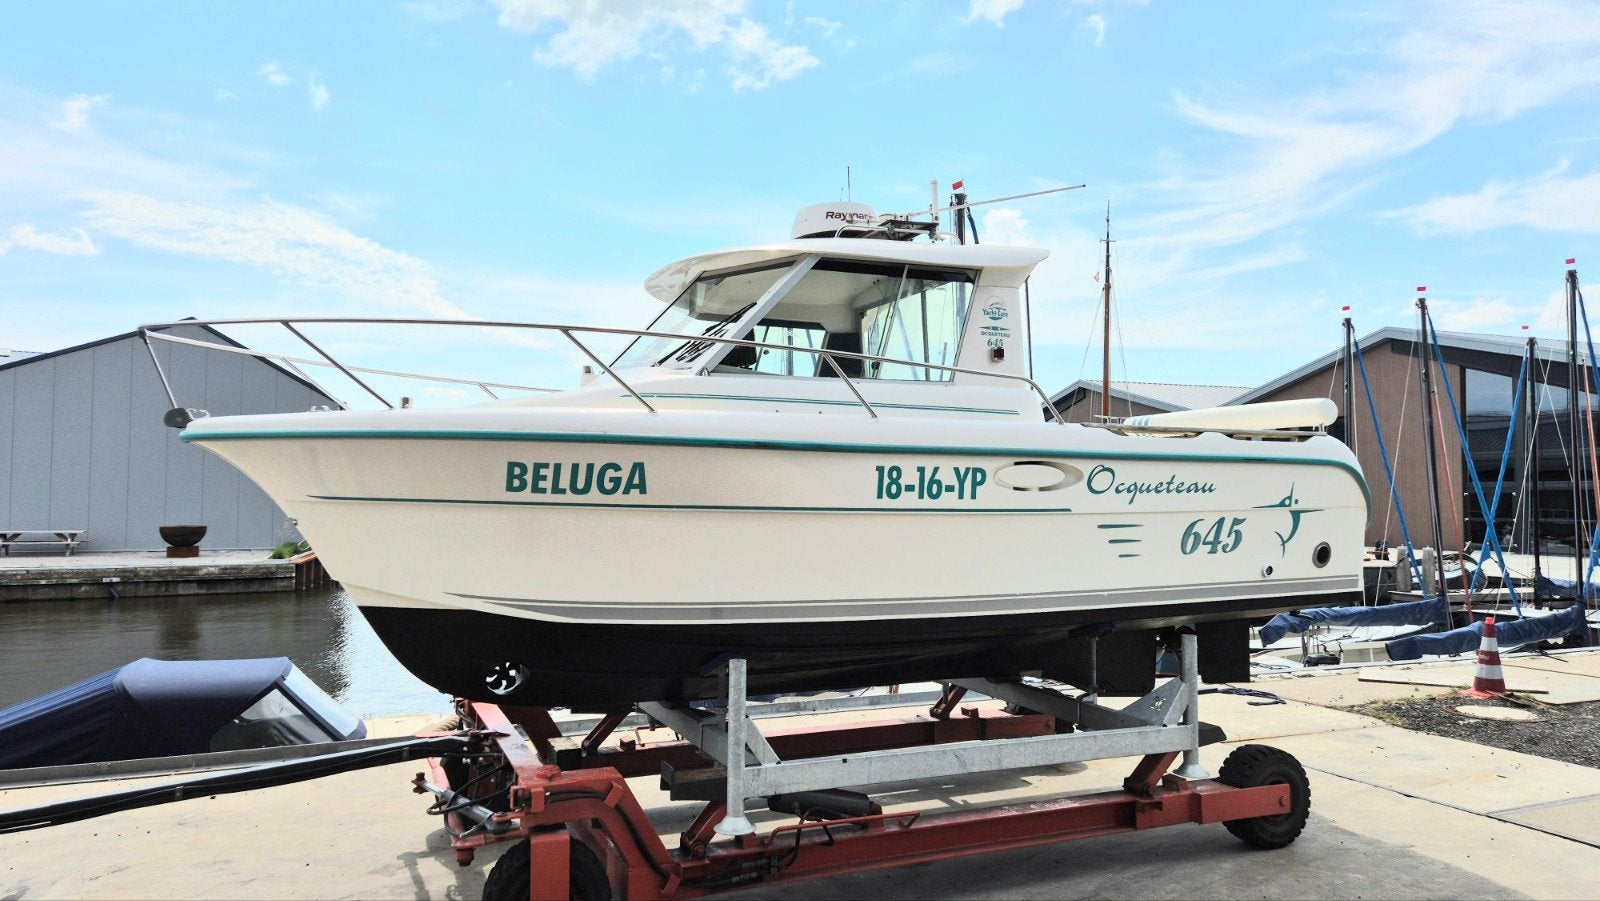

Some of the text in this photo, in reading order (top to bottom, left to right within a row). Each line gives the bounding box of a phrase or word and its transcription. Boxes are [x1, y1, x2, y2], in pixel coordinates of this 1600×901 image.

[982, 308, 1009, 318] Yacht Care
[987, 338, 1004, 347] 645
[506, 461, 648, 495] BELUGA
[876, 466, 987, 500] 18-16-YP
[1087, 464, 1217, 505] Ocqueteau
[1180, 516, 1247, 556] 645
